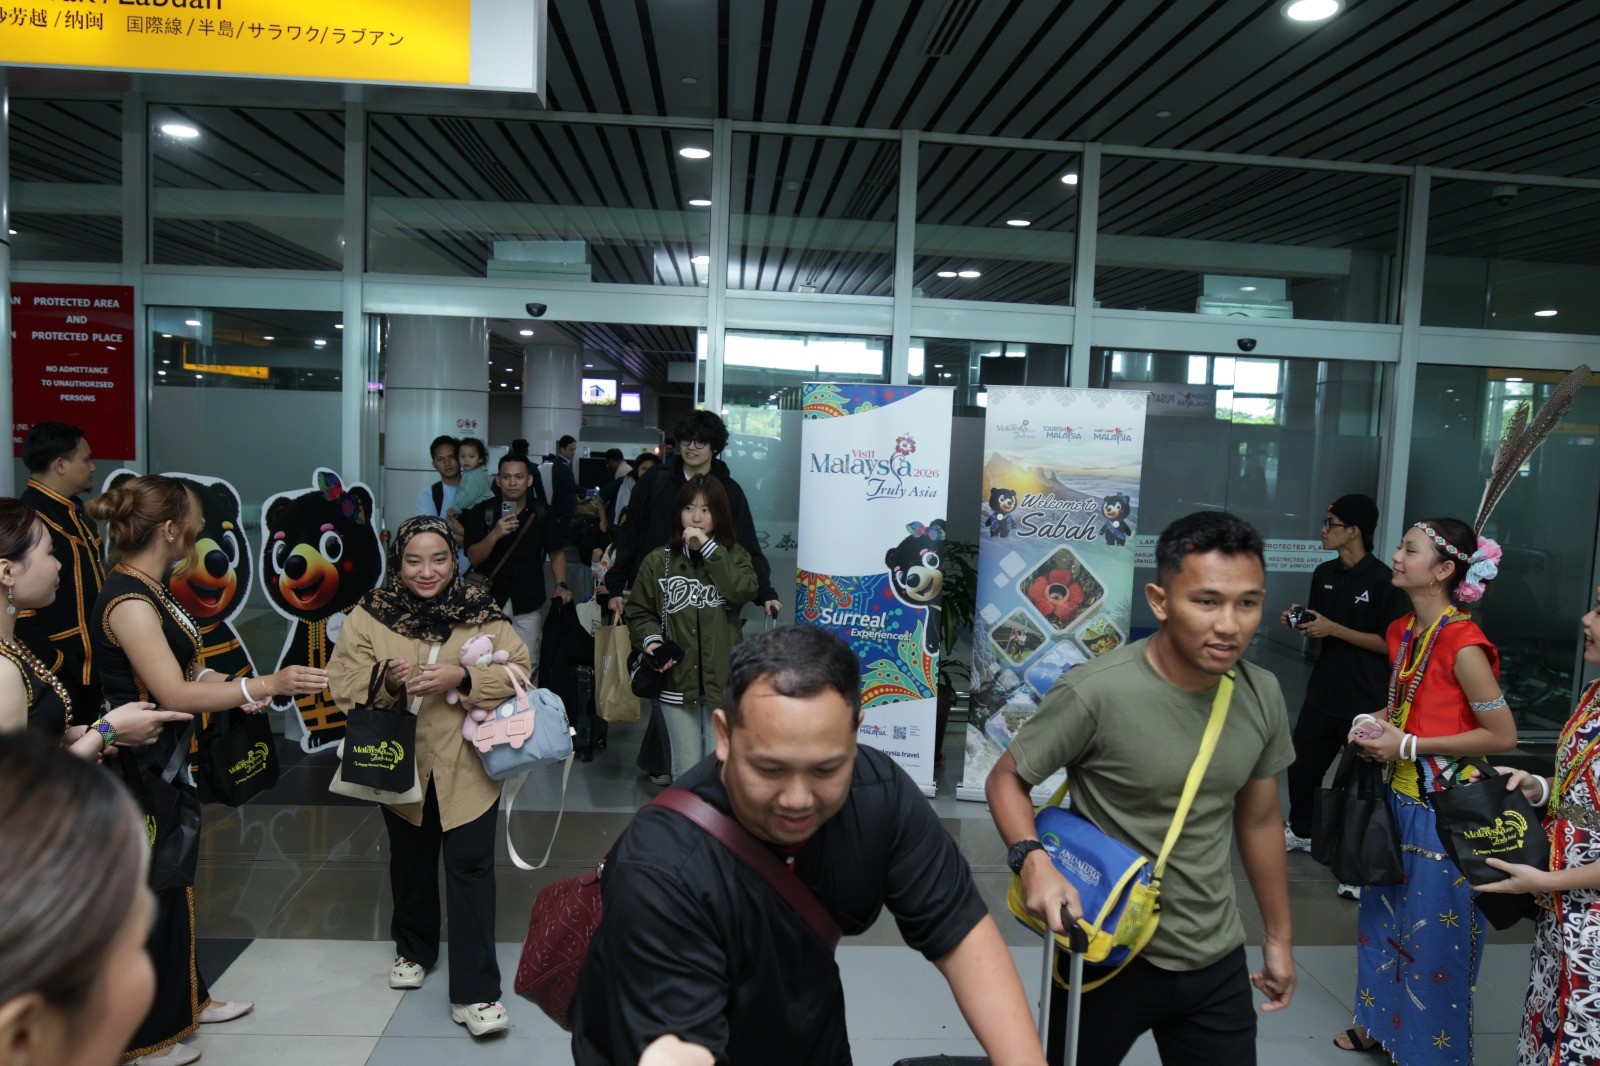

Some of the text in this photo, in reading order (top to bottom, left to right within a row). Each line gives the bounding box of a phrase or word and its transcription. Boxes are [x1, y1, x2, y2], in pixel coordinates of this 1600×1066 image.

[33, 296, 120, 308] PROTECTED AREA
[66, 315, 88, 324] AND
[31, 331, 123, 343] PROTECTED PLACE
[45, 365, 109, 374] NO ADMITTANCE
[53, 380, 114, 388] UNAUTHORISED
[60, 394, 96, 402] PERSONS
[1046, 432, 1082, 442] MALAYSIA
[1093, 433, 1132, 445] MALAYSIA
[851, 449, 876, 459] Visit
[809, 452, 940, 481] Malaysia 2026
[866, 478, 938, 501] Truly Asia
[1020, 493, 1099, 512] Welcome to
[1016, 511, 1099, 542] Sabah
[819, 607, 887, 629] Surreal
[850, 628, 913, 641] Experiences!
[1463, 825, 1506, 840] Malaysia
[1059, 849, 1102, 882] ANDALUSIA
